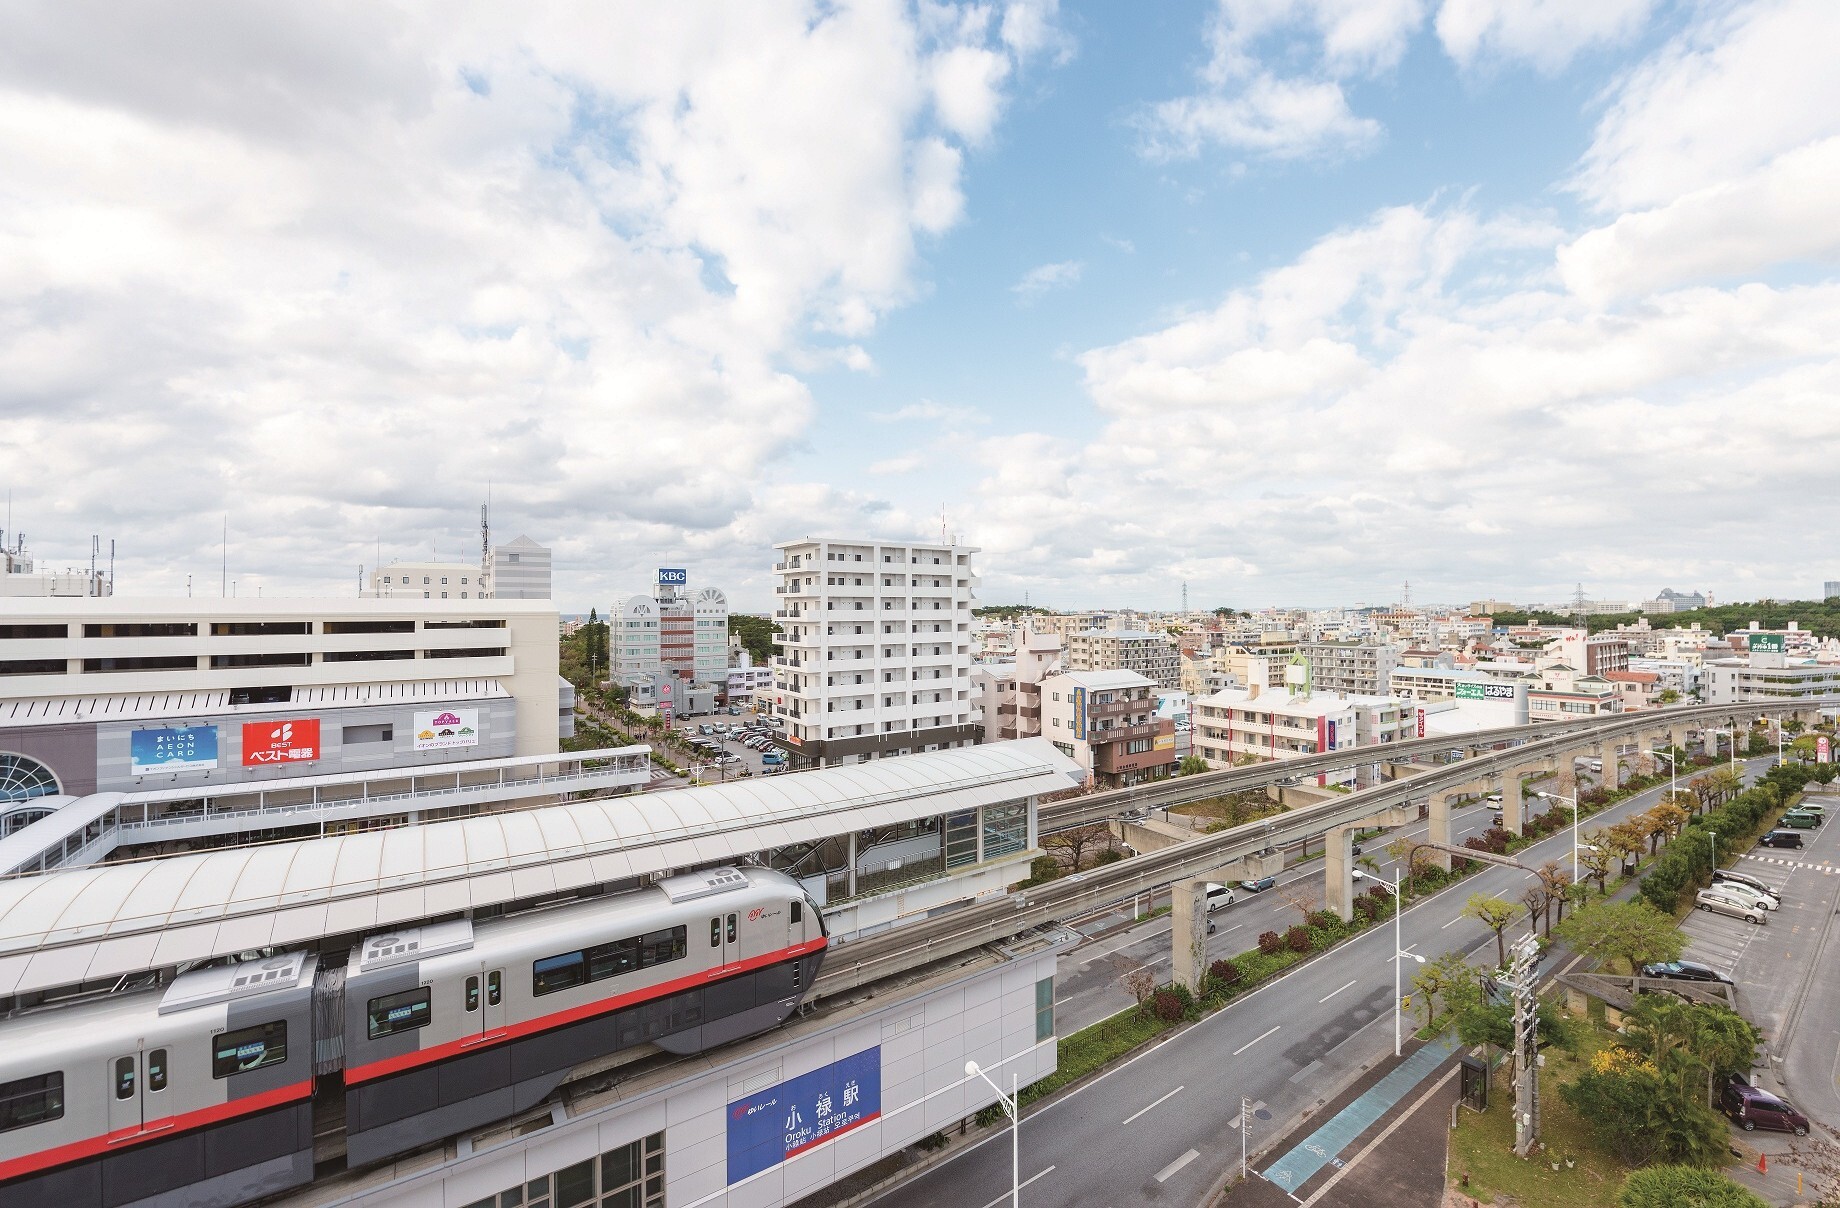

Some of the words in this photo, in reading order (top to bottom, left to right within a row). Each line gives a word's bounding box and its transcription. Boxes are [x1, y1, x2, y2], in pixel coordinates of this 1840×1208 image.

[660, 571, 685, 581] KBC
[1485, 685, 1513, 698] はるやま
[157, 733, 195, 743] まいにち
[157, 742, 194, 750] AEON
[271, 741, 292, 749] BEST
[157, 750, 194, 758] CARD
[250, 747, 314, 762] ベスト電器
[747, 1099, 778, 1116] ゆいレール
[785, 1083, 860, 1131] 小禄駅
[785, 1126, 812, 1144] Oroku
[817, 1111, 847, 1130] Station
